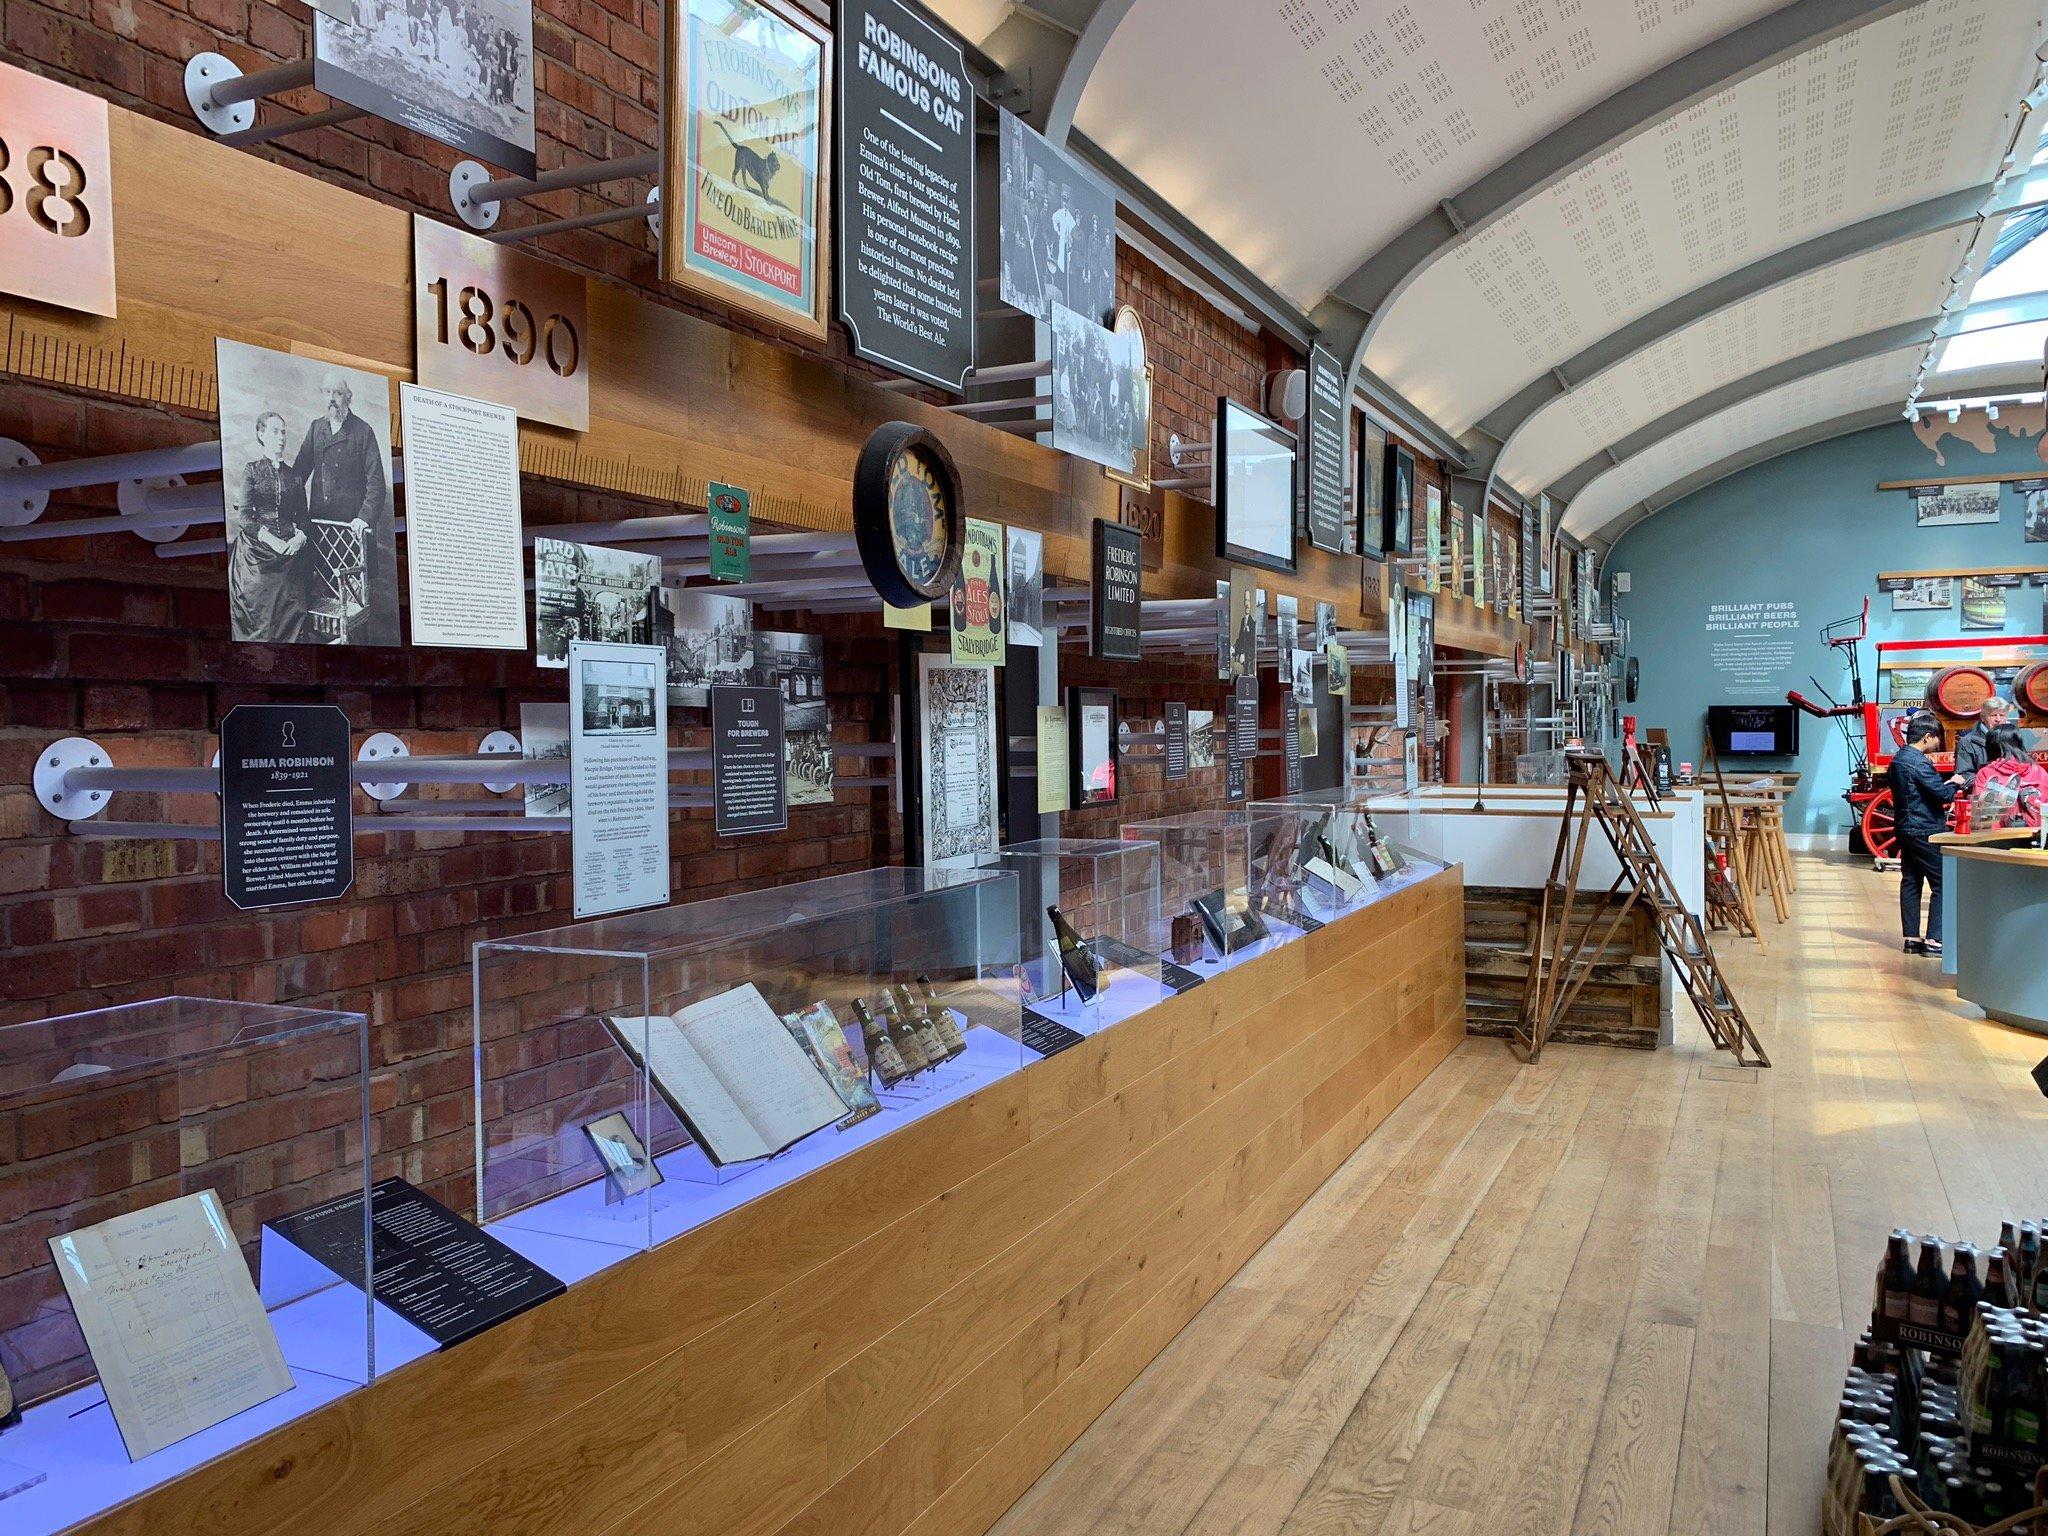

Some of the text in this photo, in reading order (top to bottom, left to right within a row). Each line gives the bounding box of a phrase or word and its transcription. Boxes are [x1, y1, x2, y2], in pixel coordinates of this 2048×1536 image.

[864, 11, 961, 103] ROBINSONS
[707, 80, 739, 122] OLD
[858, 41, 964, 135] FAMOUS CAT
[863, 126, 957, 193] One of the lasting legacies of
[859, 142, 960, 214] Emma's time is our special ale,
[701, 171, 799, 240] FINE OLD BARLEY WINE
[859, 163, 959, 230] Old Tom, first brewed by Head
[858, 180, 961, 249] Brewer, Alfred Munton in 1899.
[702, 227, 737, 252] Unicorn
[862, 202, 958, 264] His personal notebook recipe
[702, 242, 739, 268] Brewery
[867, 224, 954, 280] is one of our most precious
[860, 239, 959, 300] historical items. No doubt he'd
[857, 258, 961, 318] be delighted that some hundred
[873, 288, 949, 332] years later it was voted,
[428, 277, 579, 377] 1890
[876, 305, 946, 346] The World's Best Ale.
[413, 395, 434, 406] DEATH
[448, 403, 482, 415] STOCKPORT
[482, 411, 506, 421] BREWER
[711, 516, 747, 535] Robinson's
[1126, 501, 1162, 542] 1920
[899, 553, 930, 579] ALE
[1107, 546, 1137, 566] FREDERIC
[1105, 565, 1138, 585] ROBINSON
[966, 590, 989, 604] ALES
[1108, 585, 1135, 604] LIMITED
[1711, 601, 1794, 613] BRILLIANT PUBS
[966, 606, 989, 623] STOUT
[1705, 620, 1800, 631] BRILLIANT PEOPLE
[1708, 611, 1797, 622] BRILLIANT BEERS
[957, 635, 999, 657] STALYBRIDGE
[727, 728, 769, 738] FOR BREWERS
[737, 720, 759, 728] TOUGH
[241, 756, 335, 769] EMMA ROBINSON
[270, 772, 309, 781] 1839-1921
[304, 1208, 335, 1221] FUTURE
